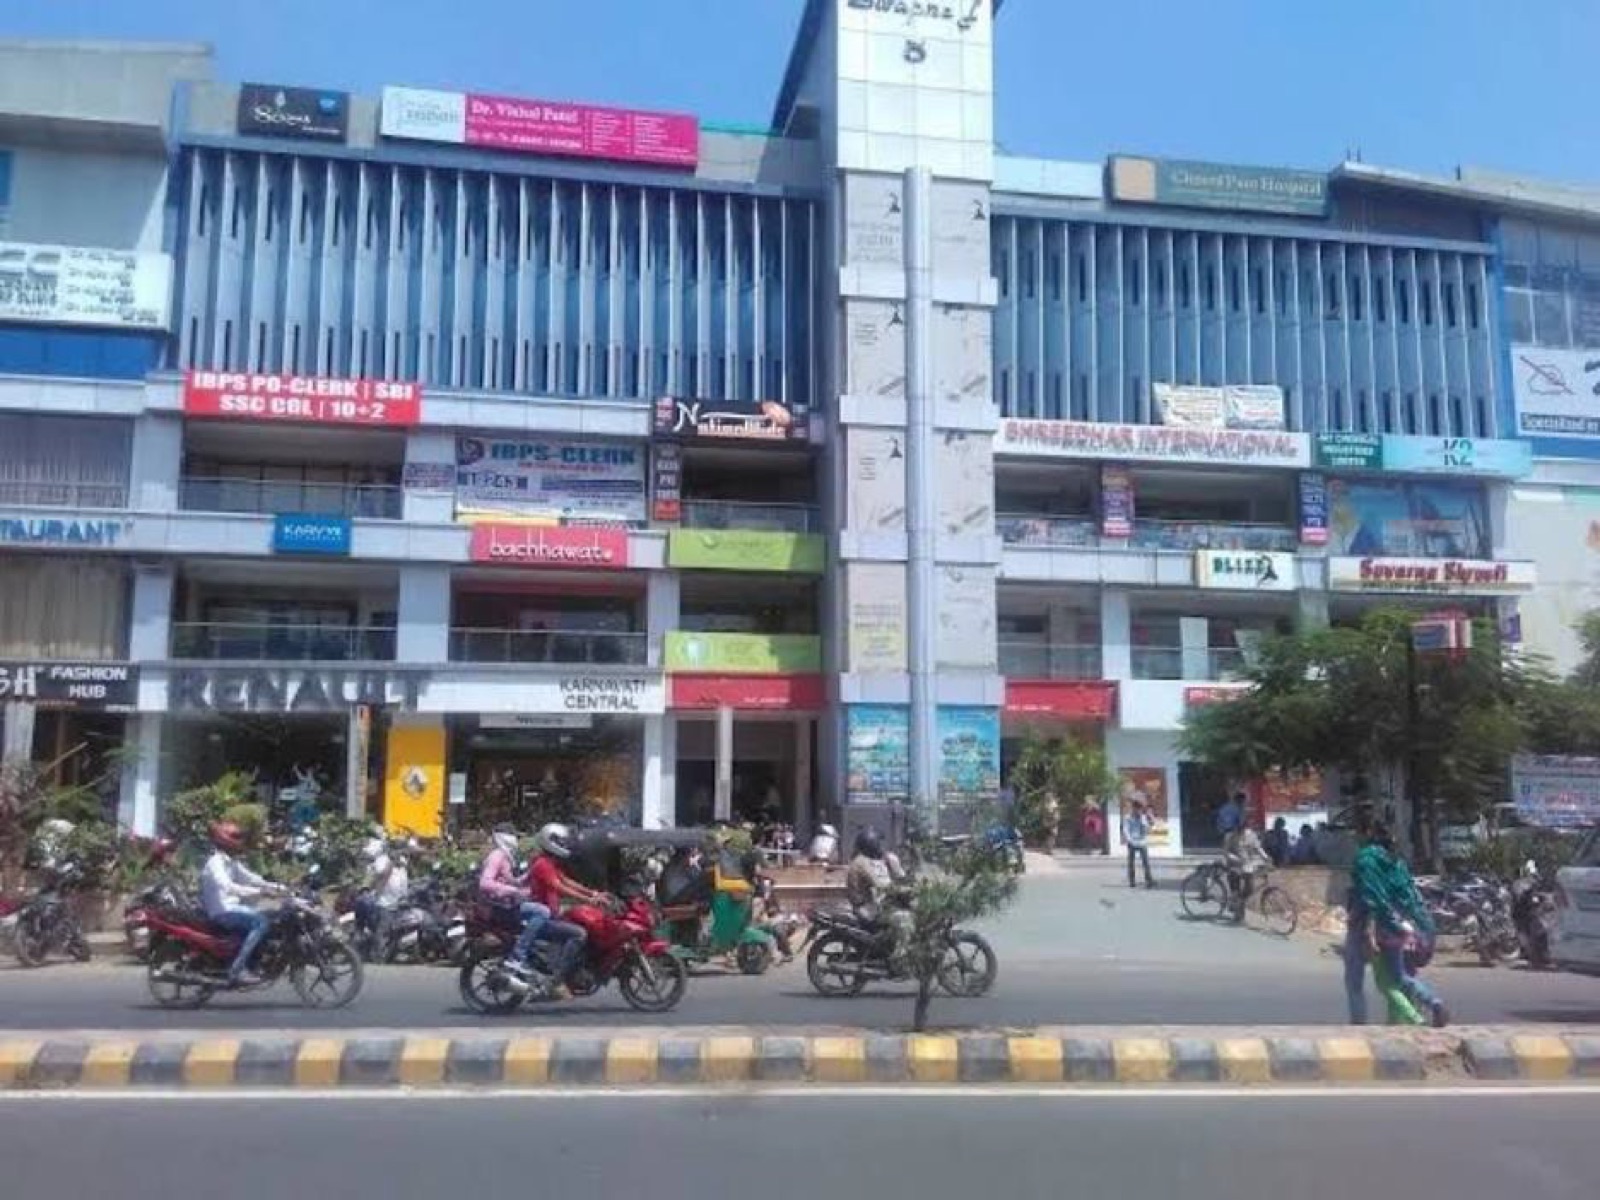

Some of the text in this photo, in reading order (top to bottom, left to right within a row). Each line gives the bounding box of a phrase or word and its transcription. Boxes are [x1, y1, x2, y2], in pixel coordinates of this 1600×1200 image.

[472, 100, 493, 117] Dr.
[194, 372, 413, 400] IBPS PO-CLERK SBI
[219, 394, 266, 413] SSC
[270, 397, 314, 416] CGL
[1444, 438, 1473, 466] K2
[51, 666, 128, 681] FASHION
[69, 684, 107, 699] HUB
[560, 678, 646, 694] KARNAVATI
[564, 694, 639, 710] CENTRAL
